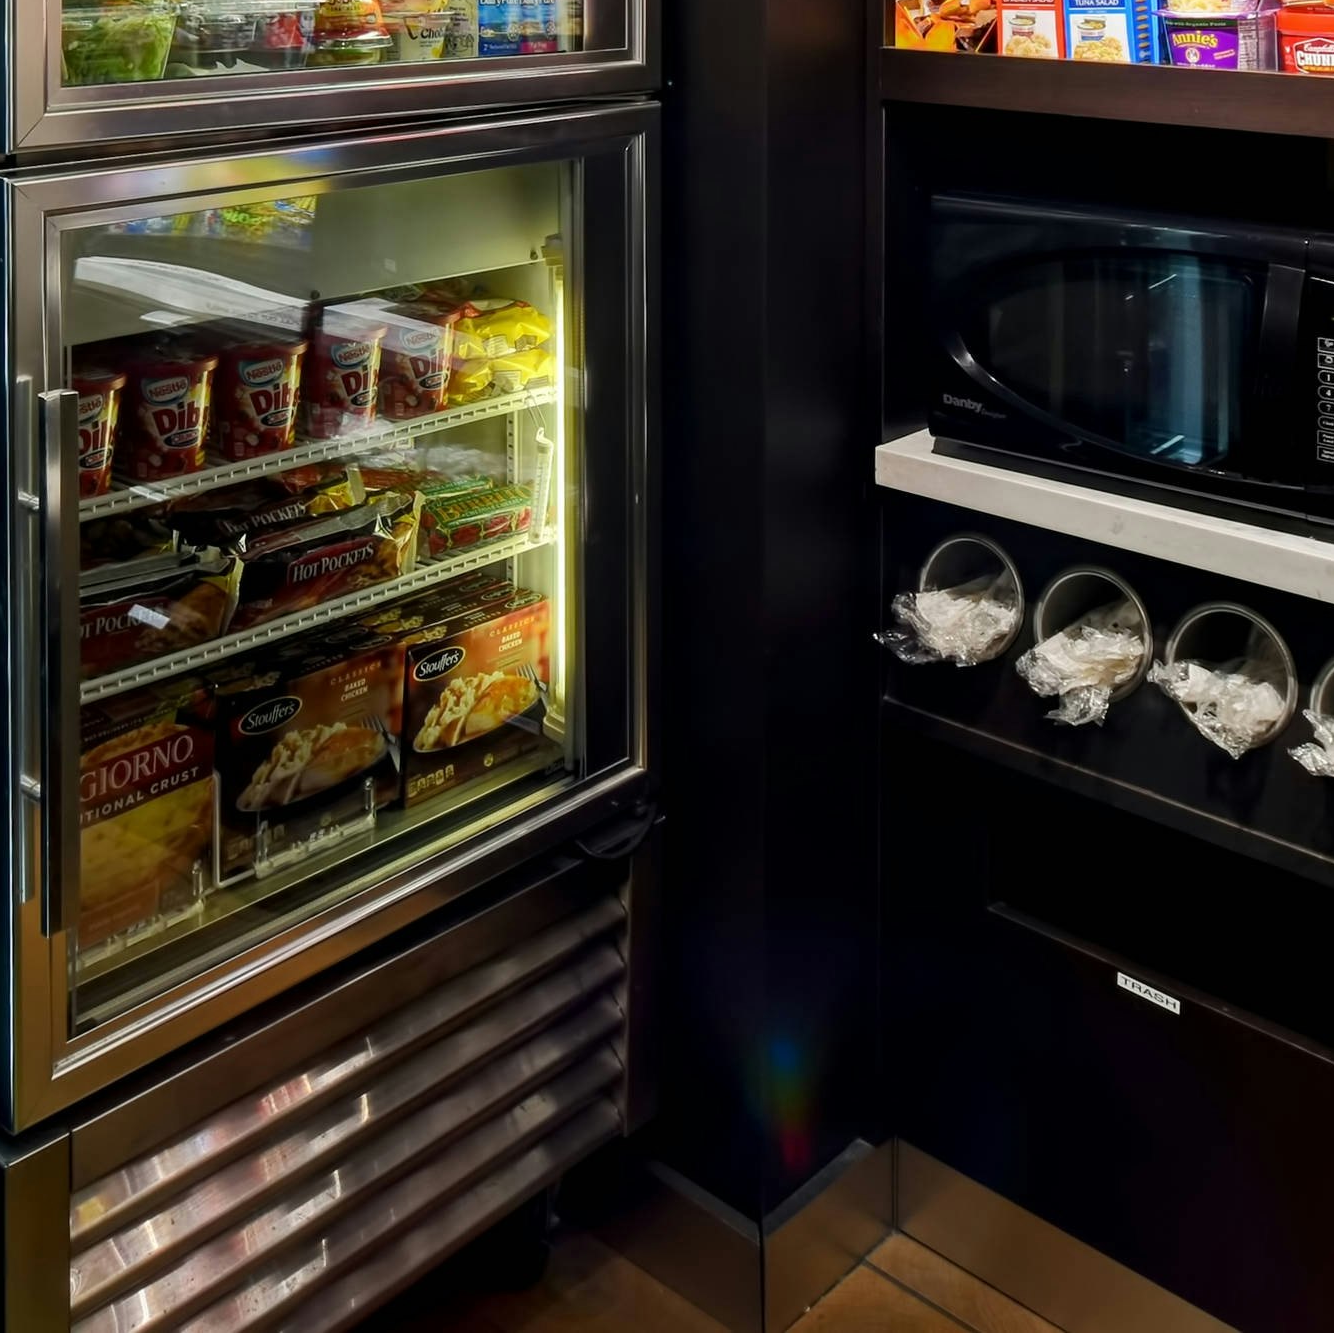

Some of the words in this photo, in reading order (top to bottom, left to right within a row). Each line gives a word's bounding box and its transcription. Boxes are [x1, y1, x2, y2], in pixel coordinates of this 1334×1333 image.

[1173, 30, 1219, 48] Annie's
[943, 394, 983, 414] Danby
[321, 542, 375, 575] POCKETS
[416, 649, 461, 678] Stouffer's
[244, 699, 298, 728] Stouffer's
[150, 767, 200, 794] CRUST
[1119, 975, 1178, 1009] TRASH
